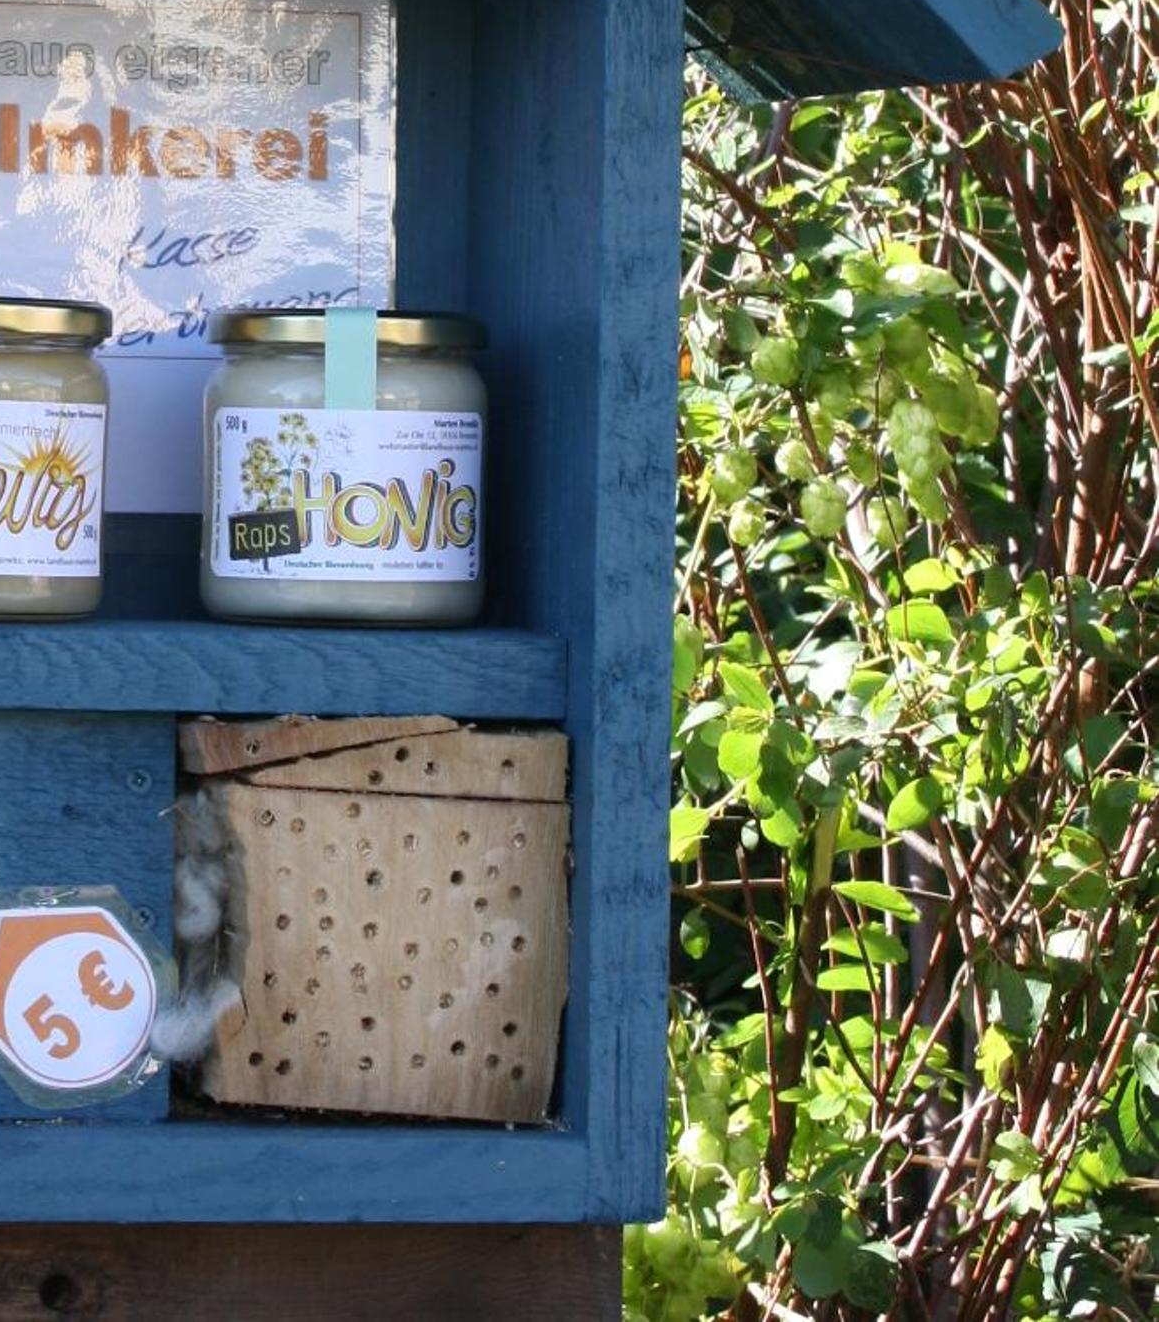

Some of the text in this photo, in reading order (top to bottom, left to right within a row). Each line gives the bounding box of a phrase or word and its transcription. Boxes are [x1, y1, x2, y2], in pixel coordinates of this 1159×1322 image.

[114, 34, 331, 92] eigener
[226, 415, 239, 430] 500
[234, 521, 292, 552] Raps
[22, 949, 135, 1060] 5 €
